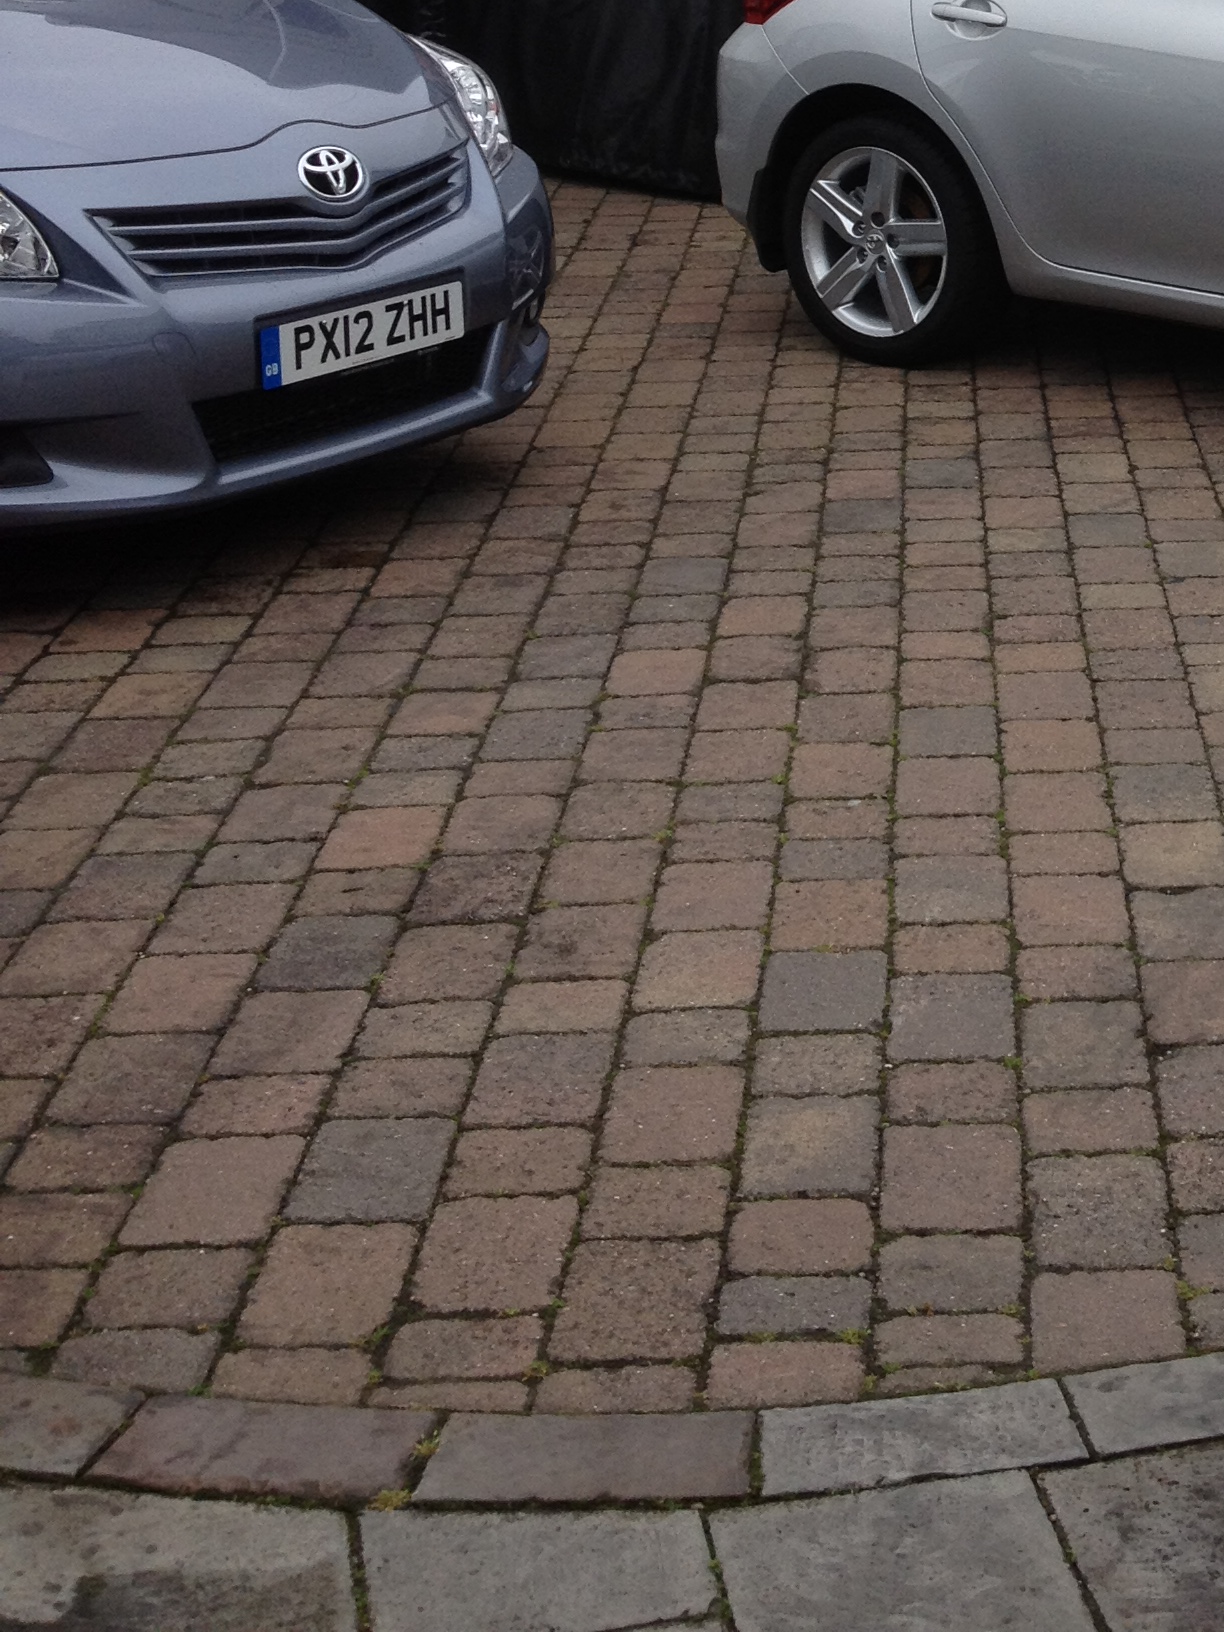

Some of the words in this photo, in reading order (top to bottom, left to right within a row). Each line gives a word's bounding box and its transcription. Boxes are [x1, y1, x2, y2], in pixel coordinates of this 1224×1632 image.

[294, 310, 375, 371] PX12
[385, 289, 451, 346] ZHH
[265, 363, 279, 377] GB
